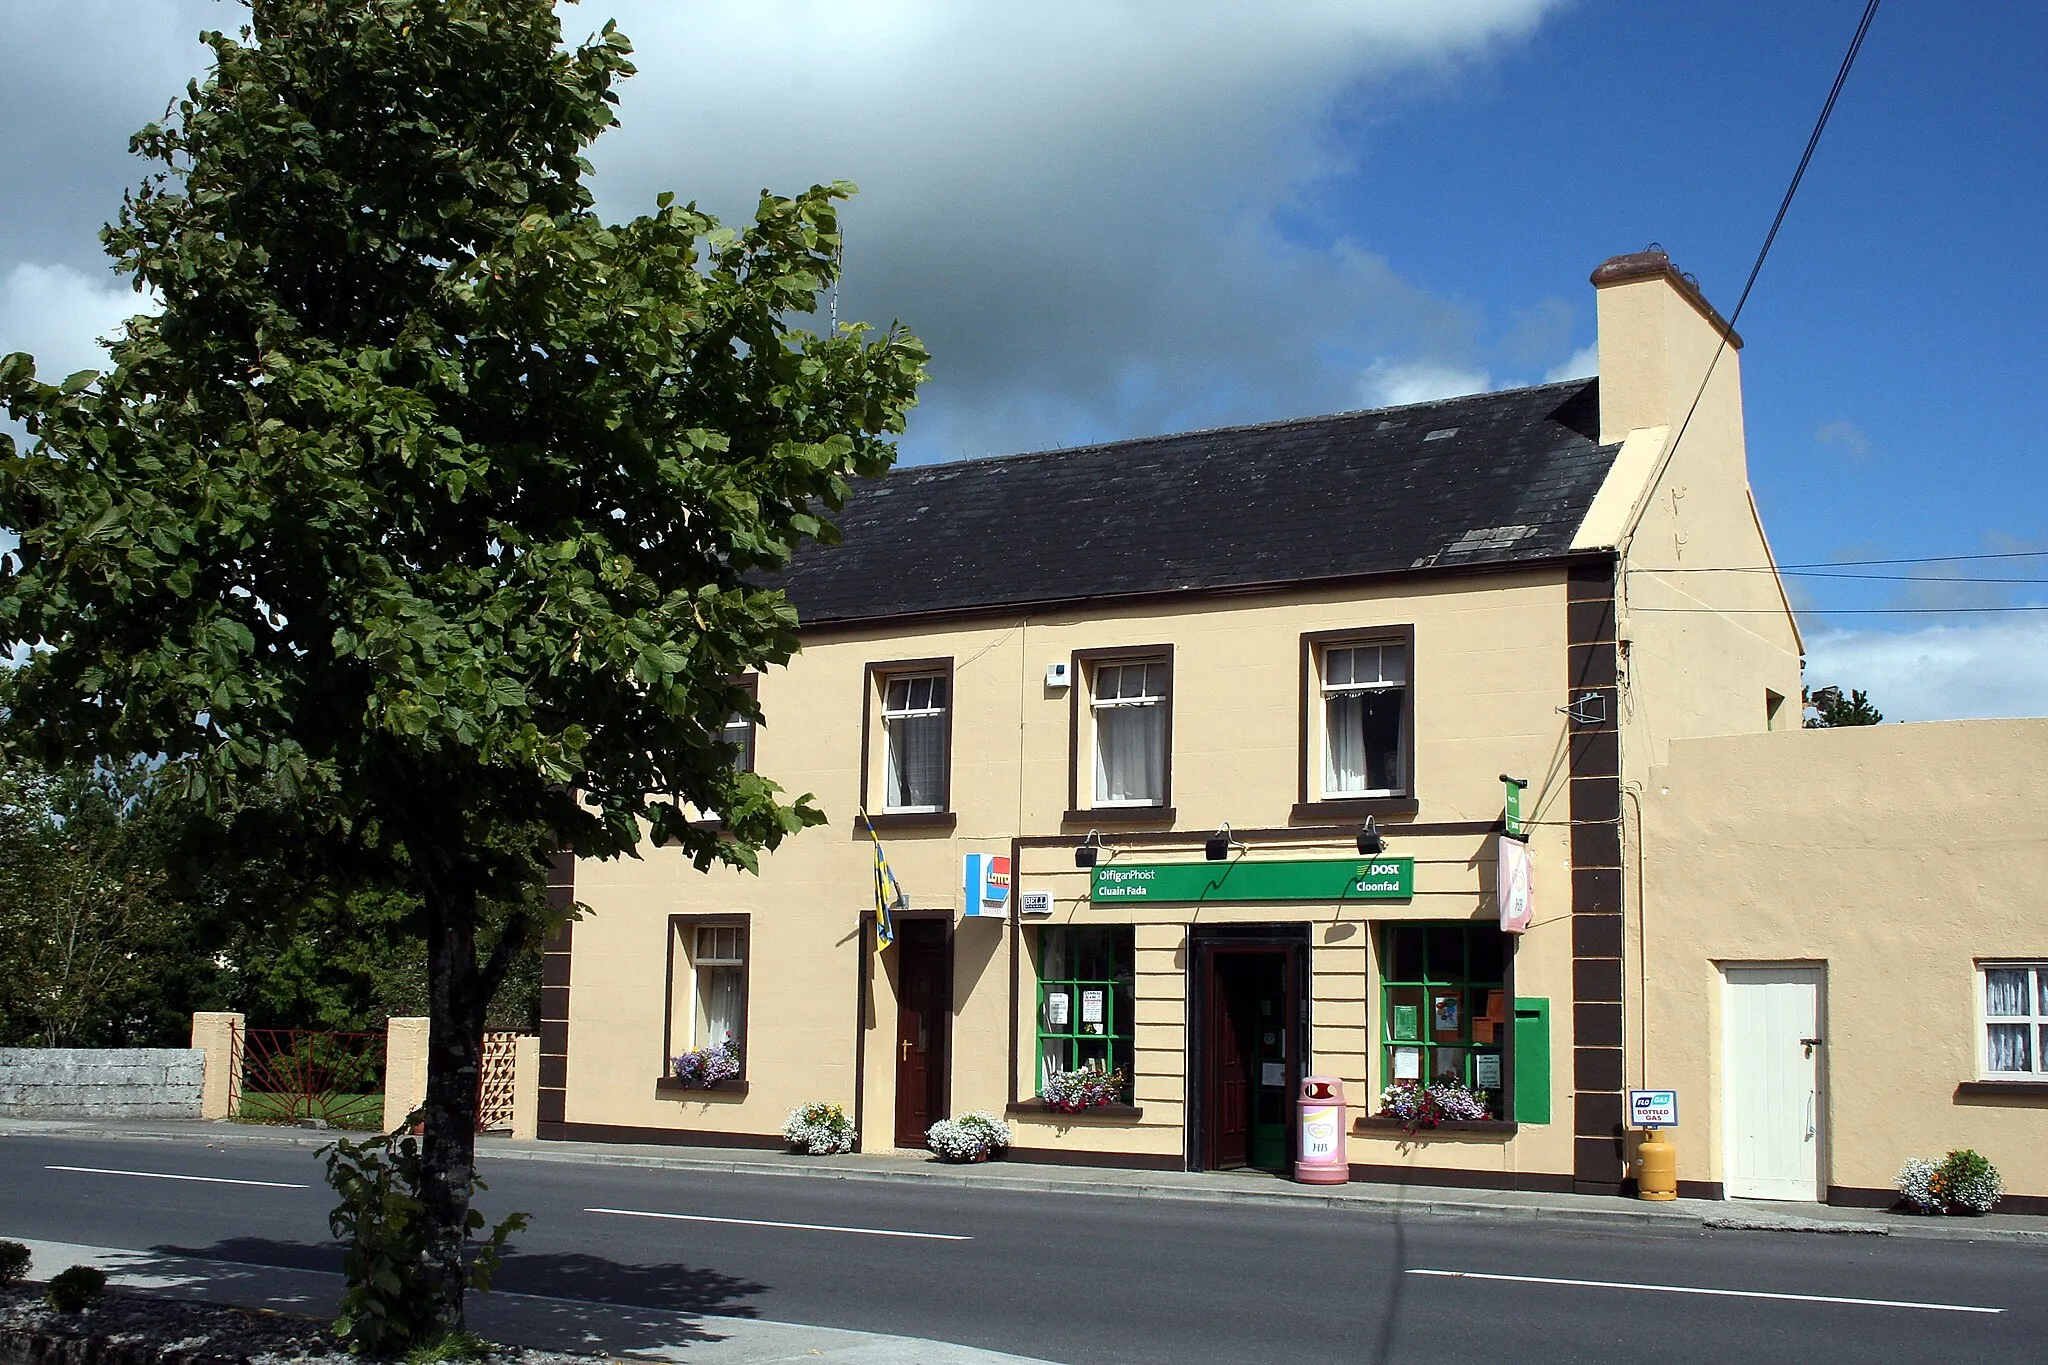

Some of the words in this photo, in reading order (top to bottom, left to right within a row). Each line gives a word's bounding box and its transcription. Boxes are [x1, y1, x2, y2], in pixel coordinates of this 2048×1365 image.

[987, 872, 1010, 885] LOTTO
[1098, 886, 1125, 896] Cluain
[1126, 885, 1147, 896] Fada
[1356, 880, 1399, 892] Cloonfad
[1025, 897, 1046, 905] BELL
[1312, 1142, 1328, 1152] HB
